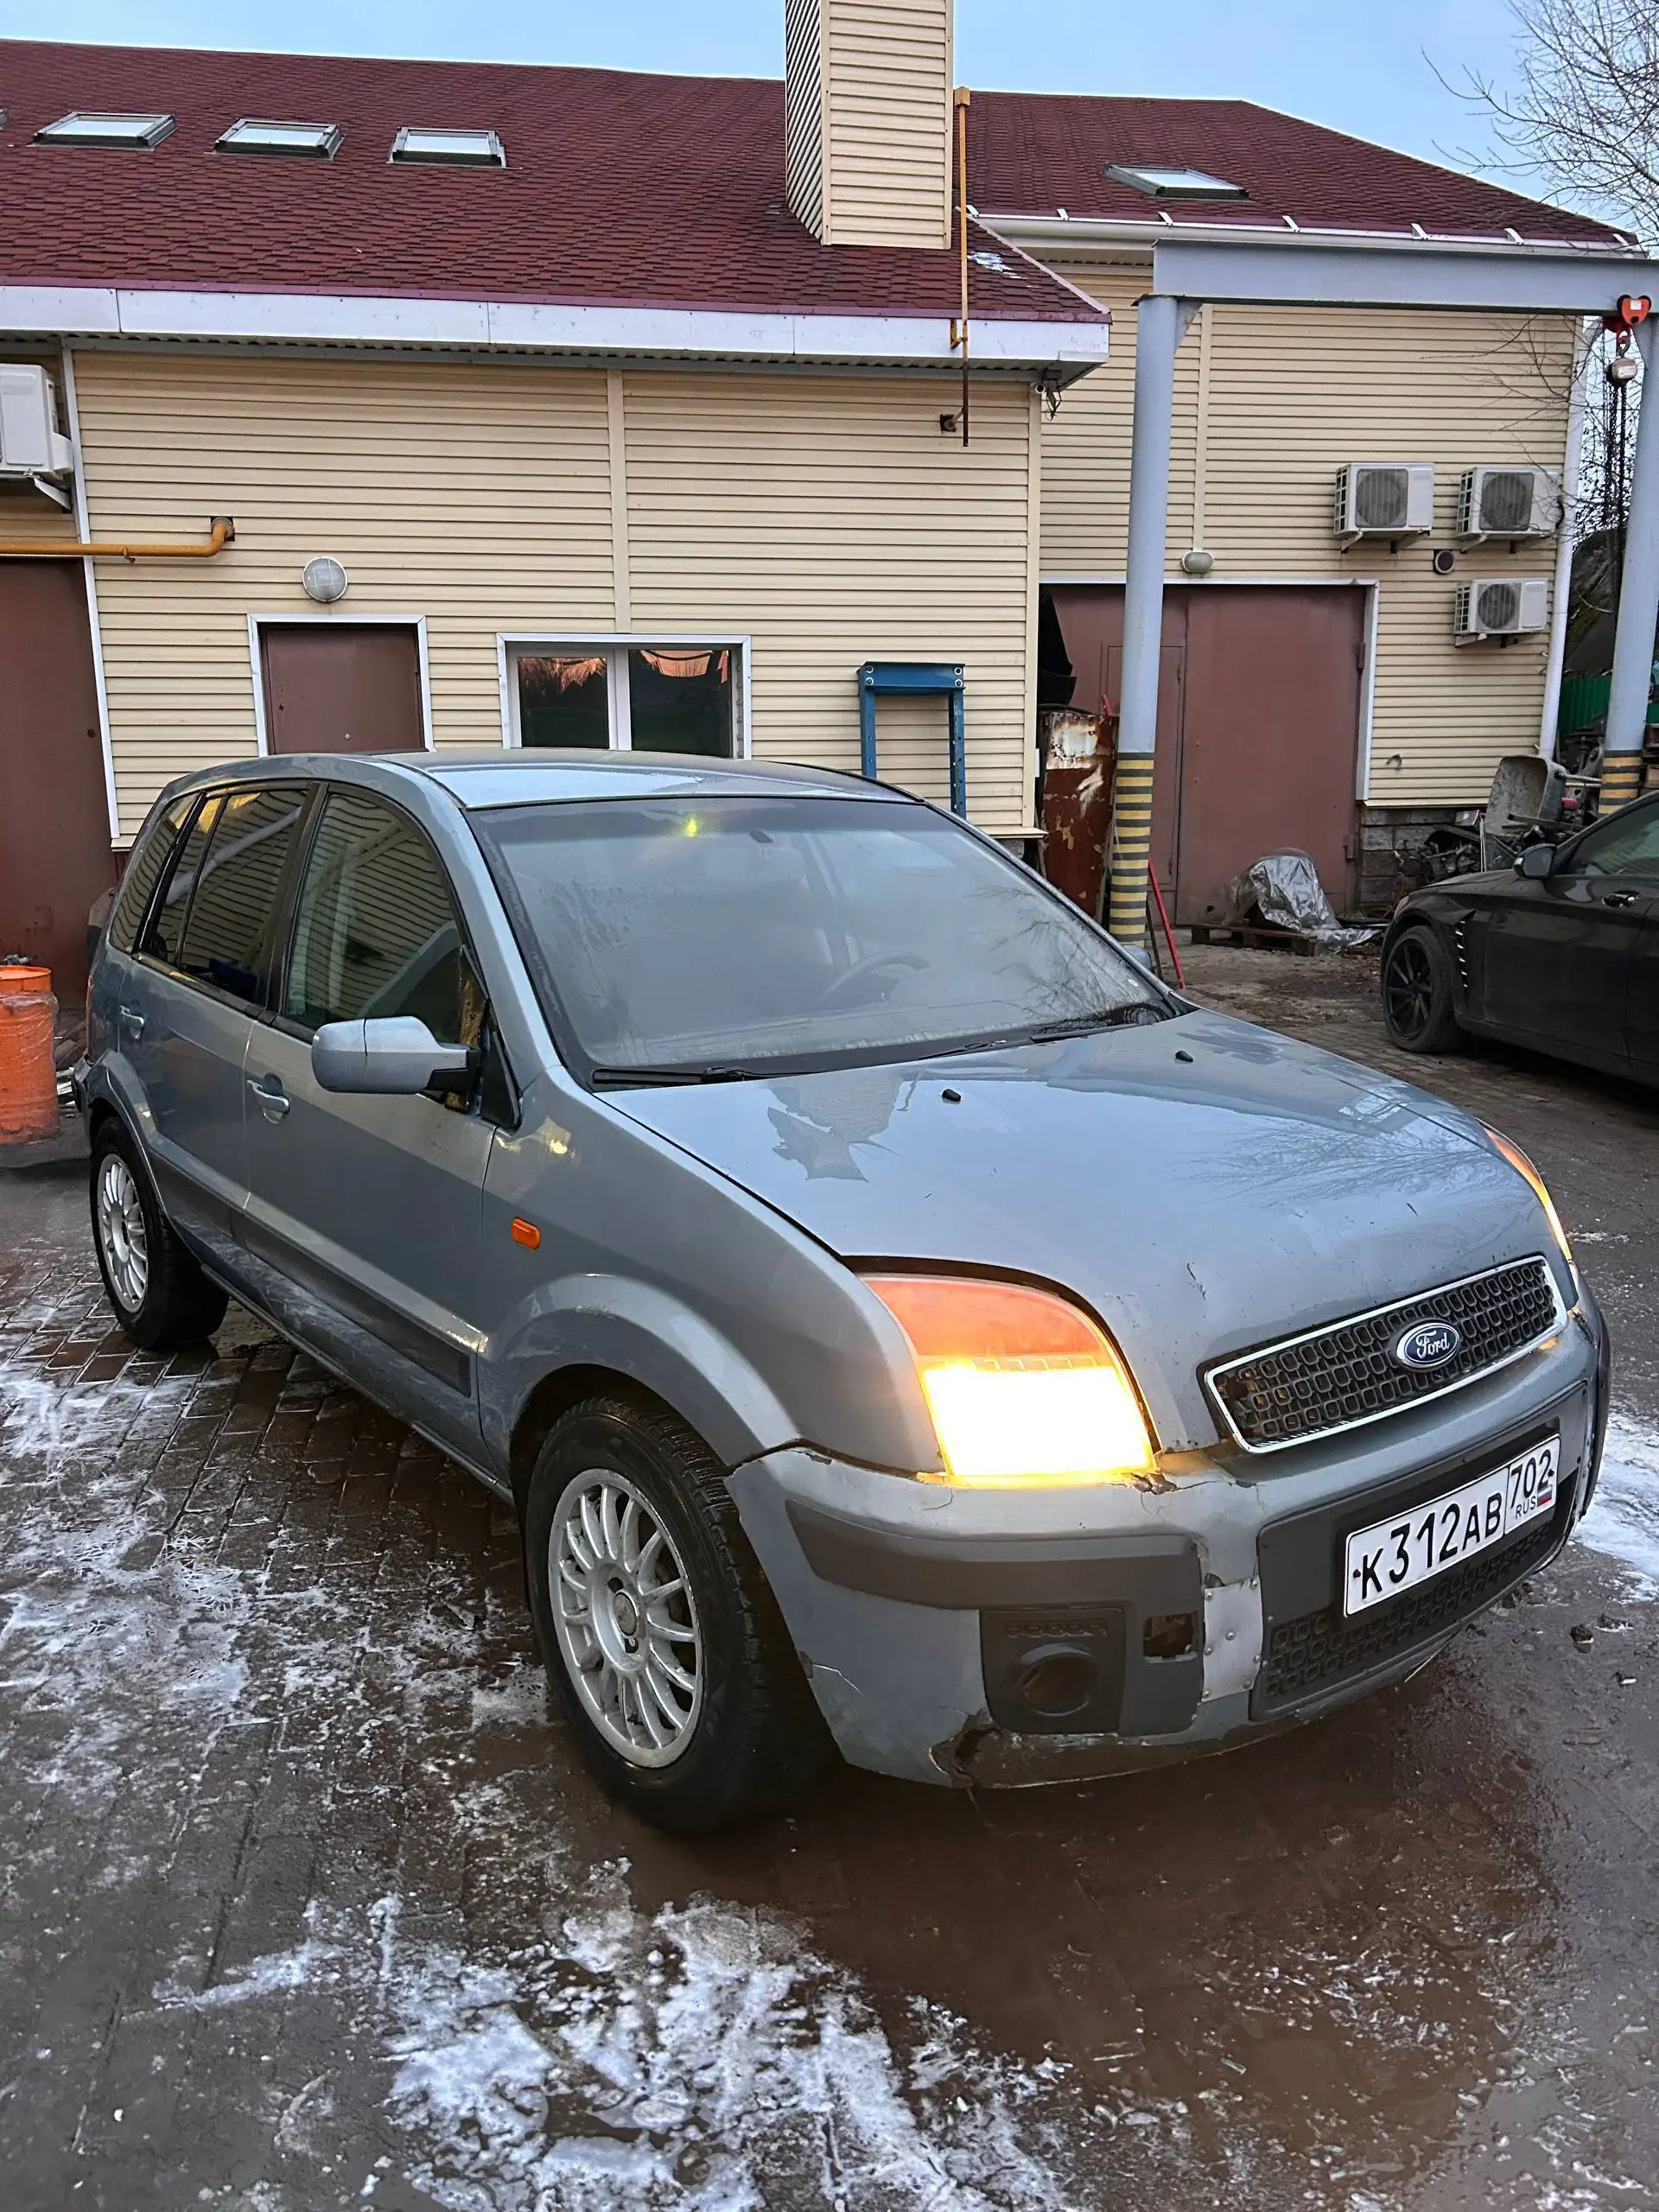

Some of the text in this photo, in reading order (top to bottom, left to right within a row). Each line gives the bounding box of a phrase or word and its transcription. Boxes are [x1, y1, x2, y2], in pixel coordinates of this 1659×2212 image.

[1415, 1330, 1450, 1358] Ford
[1515, 1496, 1537, 1520] RUS
[1361, 1449, 1552, 1599] К312АВ 702
